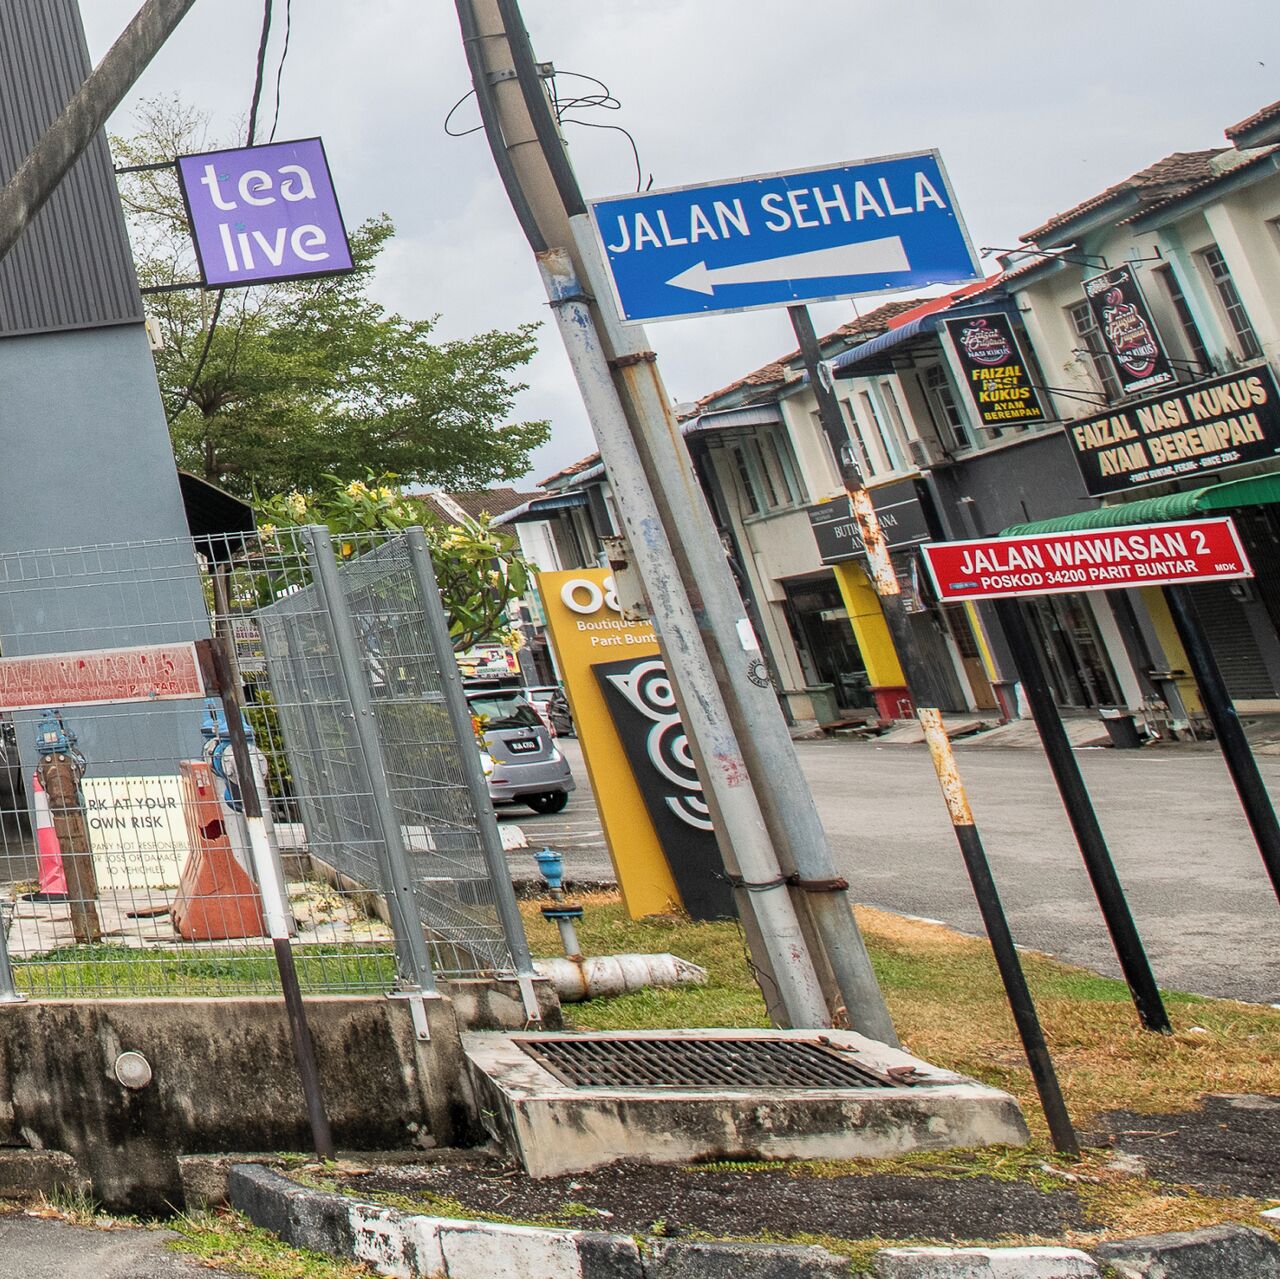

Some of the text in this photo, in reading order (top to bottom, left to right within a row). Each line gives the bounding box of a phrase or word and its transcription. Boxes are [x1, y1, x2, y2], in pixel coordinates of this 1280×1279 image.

[200, 164, 317, 211] tea
[607, 170, 947, 254] JALAN SEHALA
[218, 223, 330, 272] live
[972, 365, 1023, 381] FAIZAL
[979, 387, 1031, 403] KUKUS
[994, 401, 1025, 411] AYAM
[984, 408, 1041, 420] BEREMPAH
[1072, 376, 1268, 452] FAIZAL NASI KUKUS
[1097, 412, 1265, 477] AYAM BEREMPAH
[960, 530, 1211, 575] JALAN WAWASAN 2
[1214, 562, 1237, 572] MDK
[981, 560, 1199, 590] POSKOD 34200 PARIT BUNTAR
[577, 620, 635, 632] Boutique
[591, 632, 658, 647] Parit Bunt
[88, 797, 177, 811] RK AT YOUR
[90, 816, 164, 829] OWN RISK
[91, 843, 114, 851] PANY
[116, 842, 136, 851] NOT
[106, 854, 126, 863] LOSS
[145, 853, 183, 862] DAMAGE
[107, 867, 118, 875] TO
